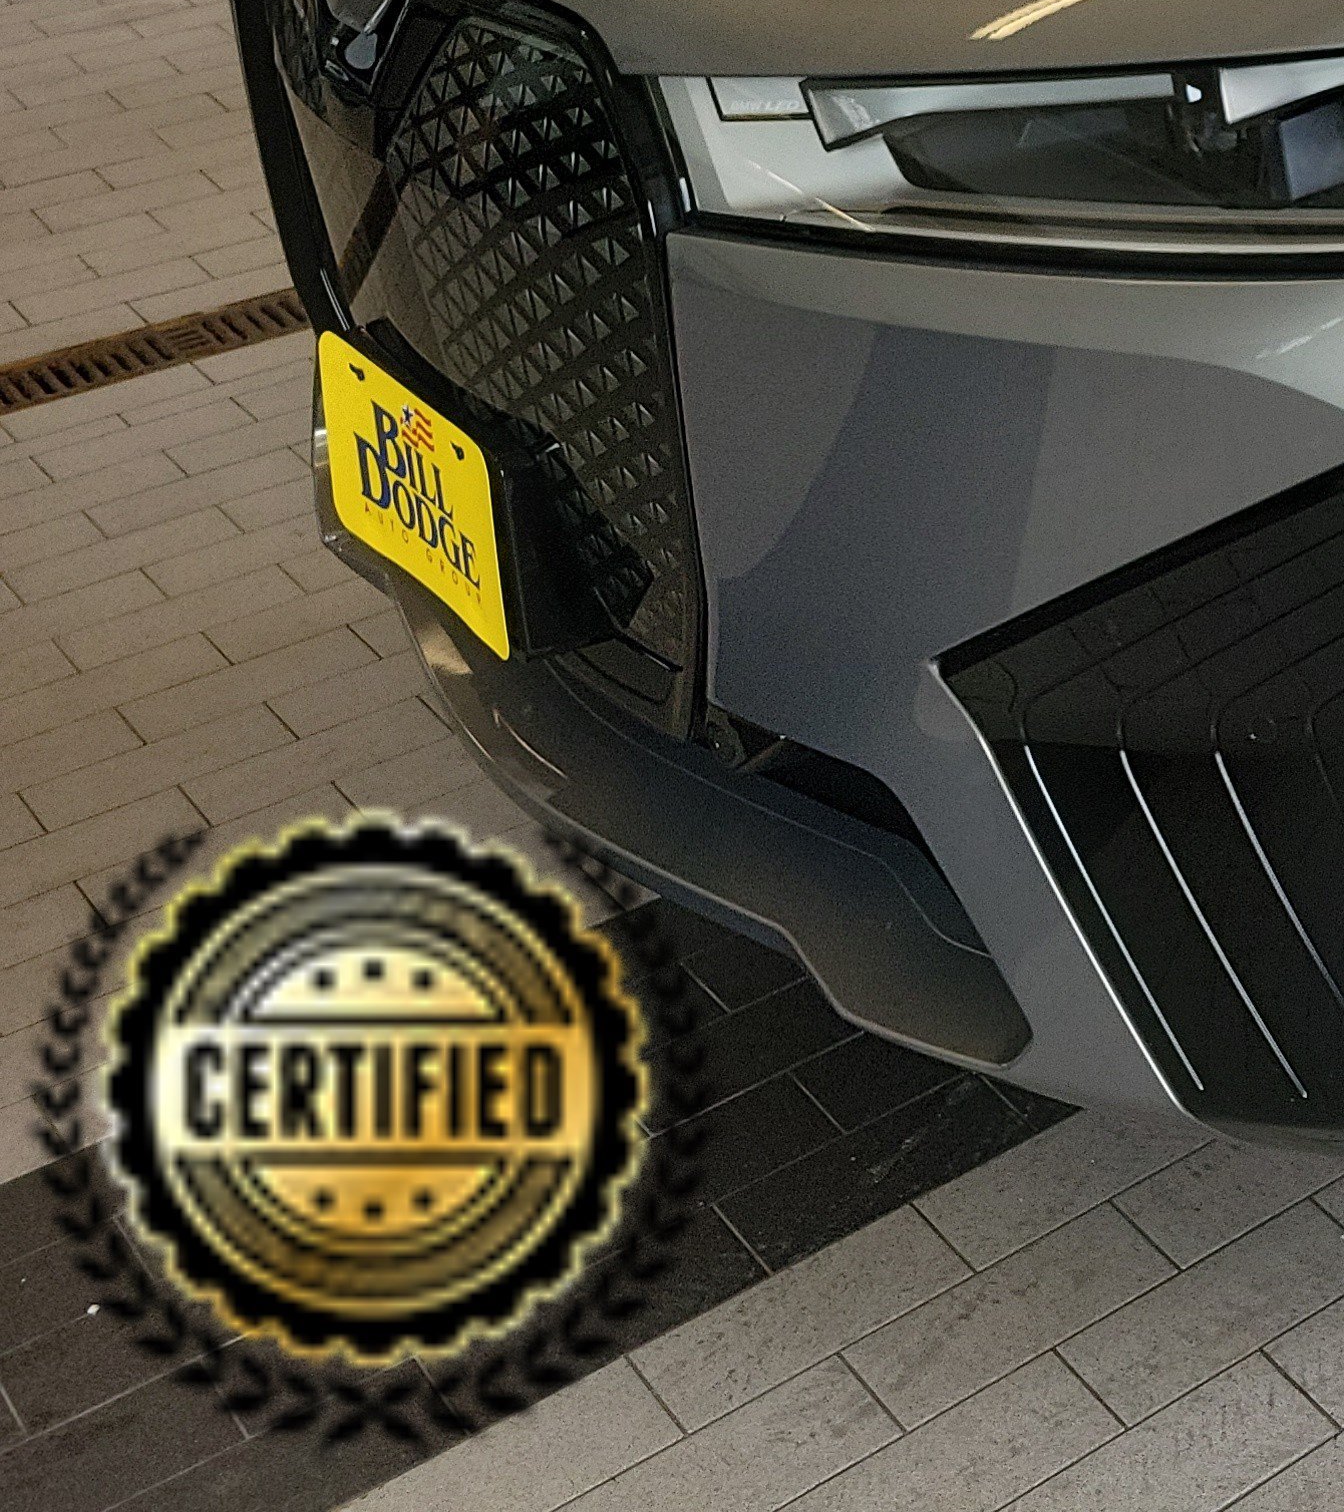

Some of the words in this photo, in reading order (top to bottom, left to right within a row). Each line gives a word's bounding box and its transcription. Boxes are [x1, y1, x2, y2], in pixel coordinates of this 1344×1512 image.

[353, 430, 481, 589] DODGE
[371, 399, 454, 521] BILL
[364, 502, 410, 544] AUTO
[425, 548, 483, 605] GROUP
